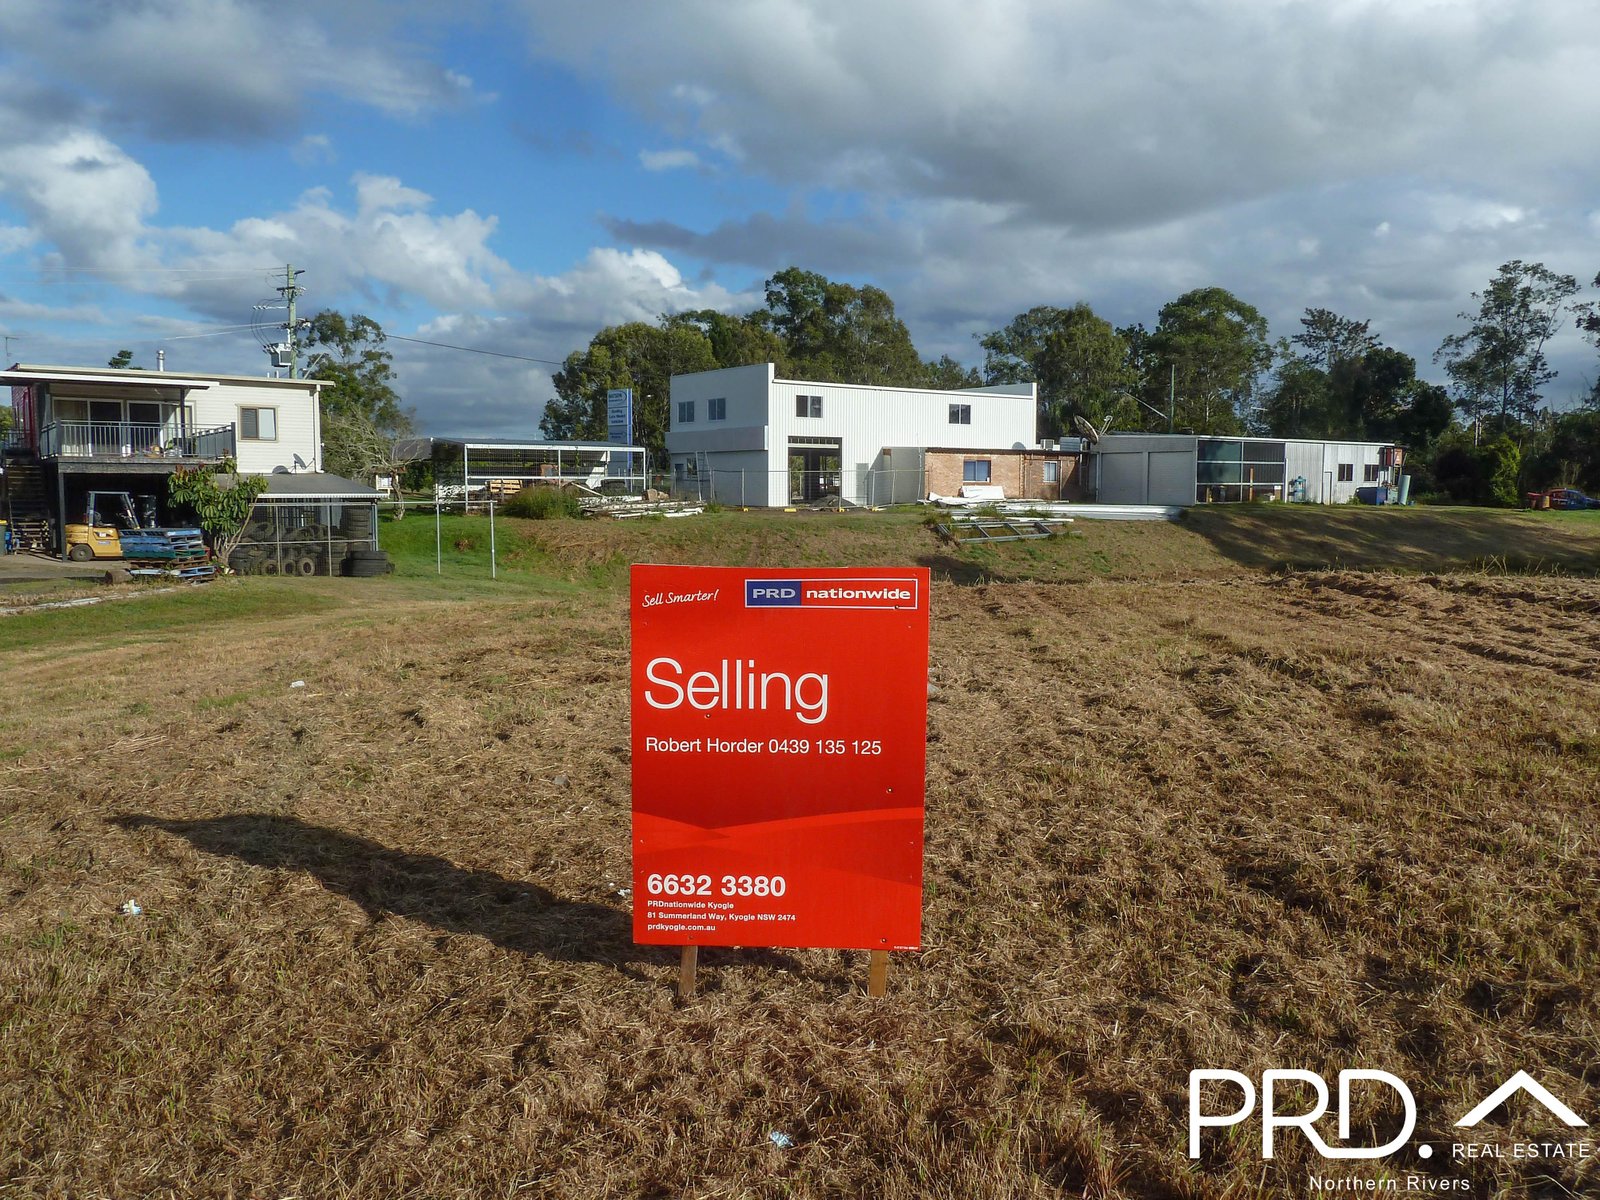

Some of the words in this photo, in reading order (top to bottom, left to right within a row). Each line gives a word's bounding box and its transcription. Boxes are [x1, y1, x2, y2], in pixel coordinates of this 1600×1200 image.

[642, 592, 664, 608] Sell
[665, 588, 720, 605] Smarter!
[752, 587, 797, 600] PRD
[806, 587, 911, 601] nationwide
[644, 657, 829, 725] Selling
[646, 737, 702, 753] Robert
[706, 737, 765, 754] Horder
[768, 739, 810, 755] 0439
[815, 739, 846, 755] 135
[851, 740, 882, 756] 125
[647, 873, 713, 896] 6632
[720, 875, 787, 898] 3380
[647, 900, 706, 909] PRDnationwide
[707, 902, 735, 911] Kyogle
[647, 911, 656, 919] 81
[658, 911, 707, 920] Summerland
[708, 913, 727, 922] Way,
[729, 913, 756, 922] Kyogle
[757, 913, 776, 921] NSW
[647, 923, 717, 932] prdkyogle.com.au
